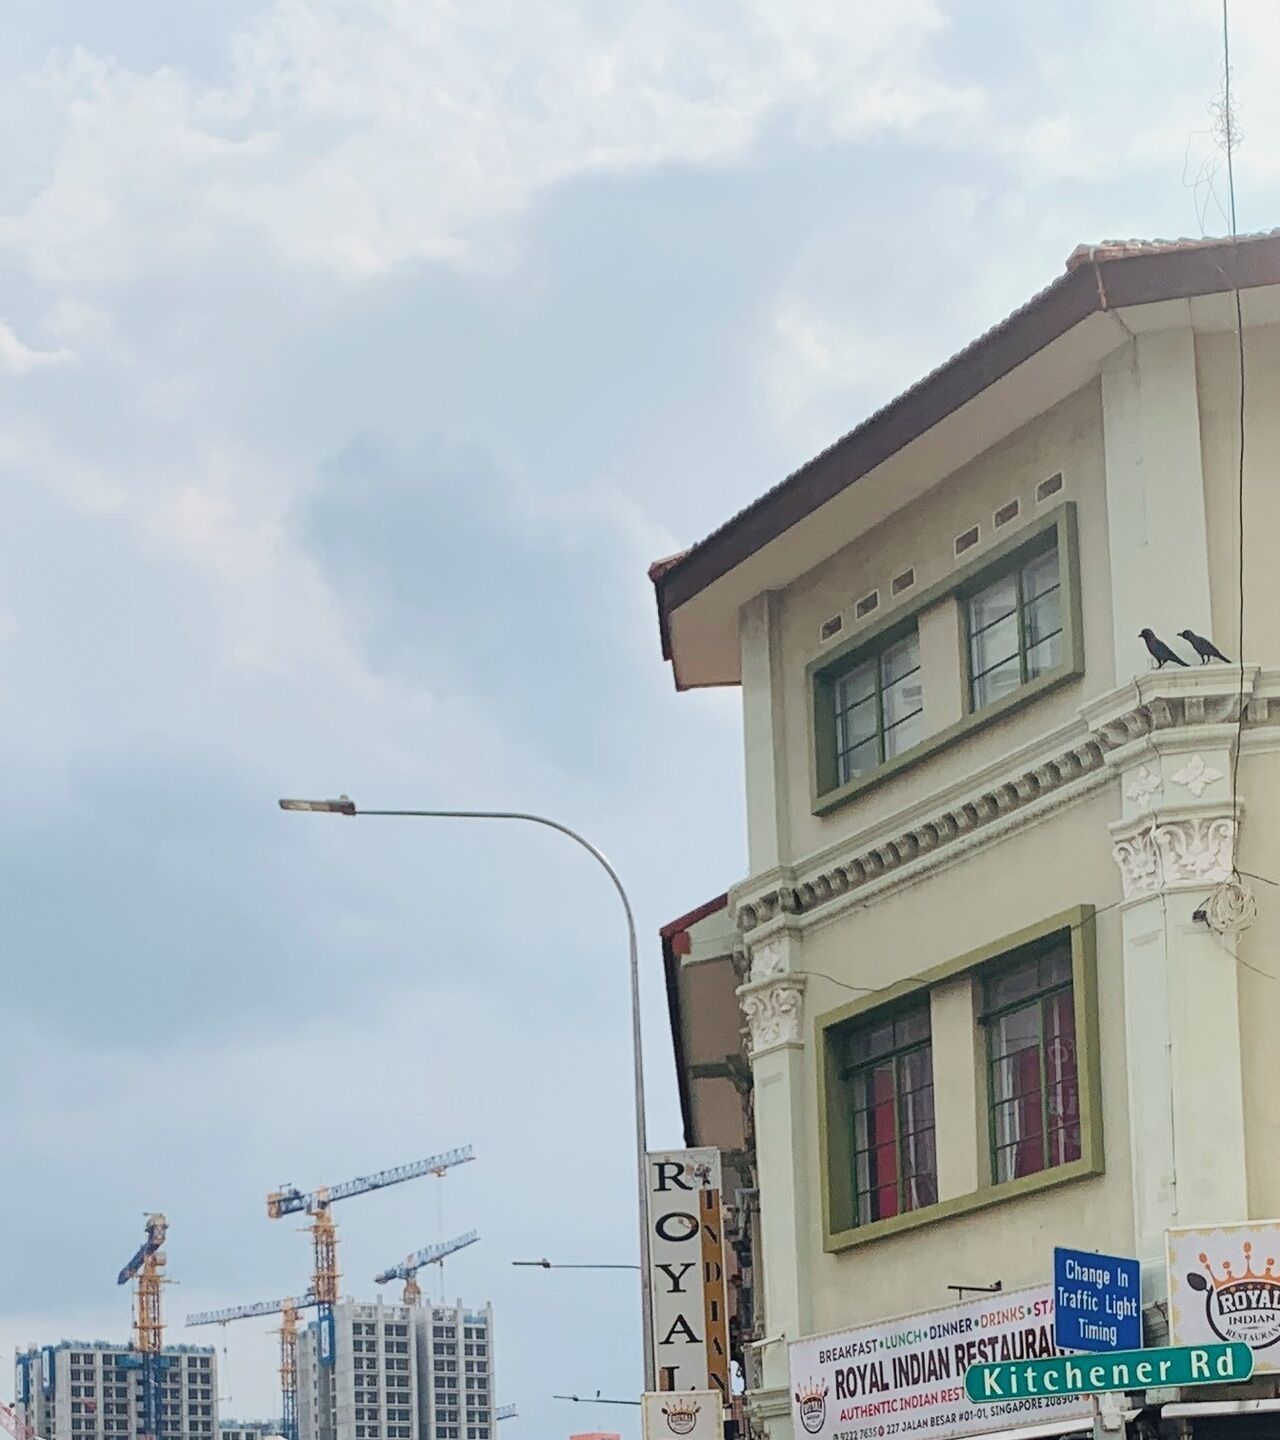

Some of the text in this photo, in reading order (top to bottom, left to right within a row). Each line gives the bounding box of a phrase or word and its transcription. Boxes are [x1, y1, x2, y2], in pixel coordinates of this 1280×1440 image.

[653, 1162, 703, 1391] ROYAL
[1065, 1259, 1129, 1289] Change In
[1058, 1286, 1099, 1312] Traffic
[1105, 1294, 1138, 1321] Light
[1228, 1313, 1275, 1326] INDIAN
[820, 1338, 879, 1364] BREAKFAST
[885, 1328, 922, 1350] LUNCH
[929, 1317, 973, 1341] DINNER
[980, 1305, 1026, 1329] DRINKS
[1078, 1317, 1117, 1347] Timing
[835, 1323, 1074, 1400] ROYAL INDIAN RESTAURA
[982, 1346, 1236, 1397] Kitchener Rd
[840, 1400, 898, 1422] AUTHENTIC
[899, 1393, 939, 1412] INDIAN
[859, 1427, 878, 1440] 7635
[886, 1423, 900, 1436] 227
[901, 1418, 929, 1433] JALAN
[930, 1412, 957, 1428] BESAR
[990, 1398, 1043, 1417] SINGAPORE
